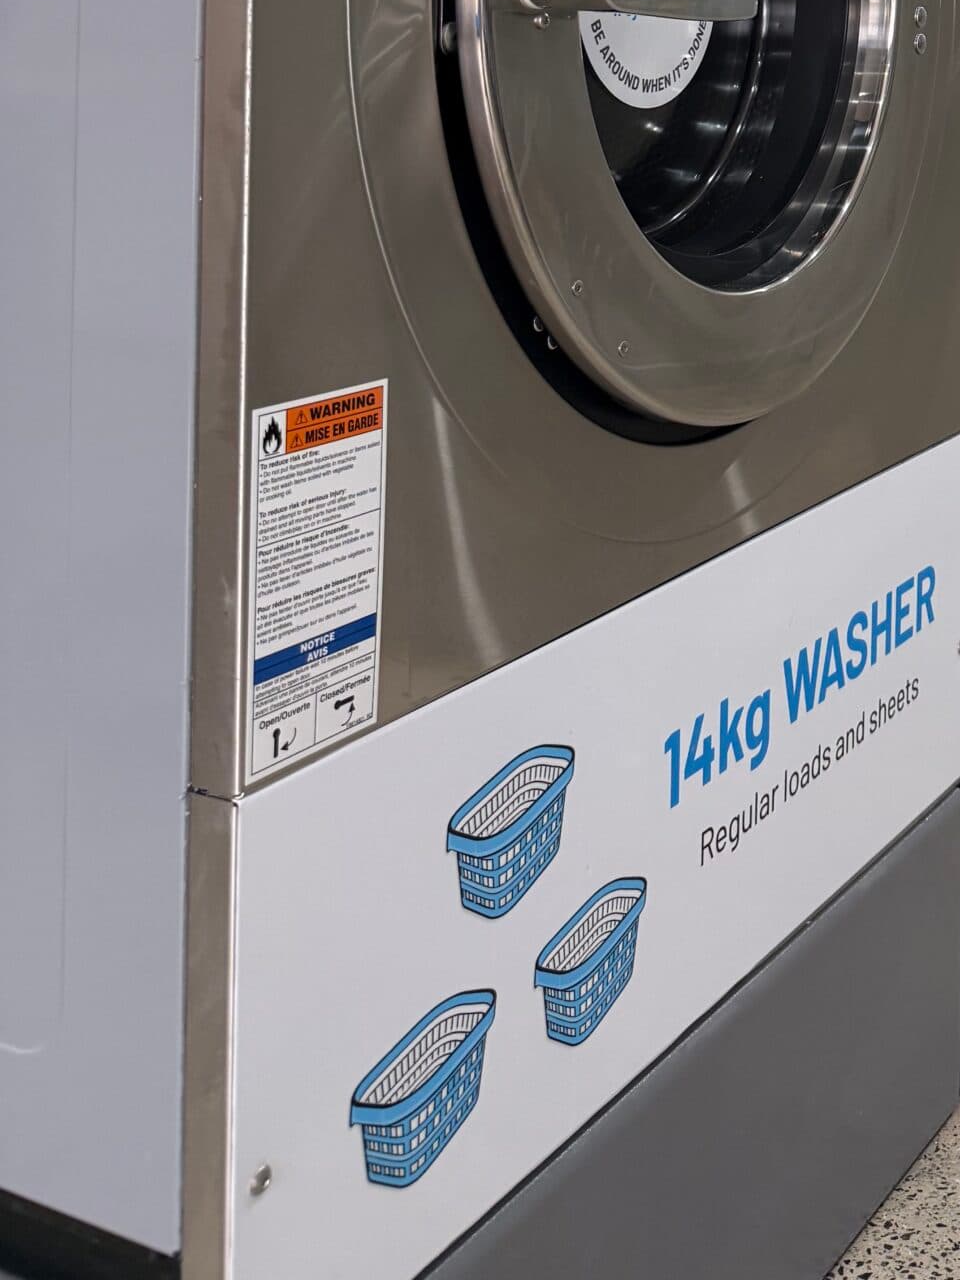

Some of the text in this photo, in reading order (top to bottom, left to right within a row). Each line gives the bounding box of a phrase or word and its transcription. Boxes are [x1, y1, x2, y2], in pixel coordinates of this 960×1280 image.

[591, 19, 706, 93] BE AROUND WHEN IT'S DONE
[310, 392, 374, 420] WARNING
[305, 413, 378, 443] MISE EN GARDE
[268, 457, 288, 468] reduce
[289, 453, 300, 462] risk
[302, 451, 307, 459] of
[309, 448, 320, 457] fire:
[259, 511, 266, 520] To
[267, 504, 288, 518] reduce
[288, 501, 299, 511] risk
[301, 498, 307, 507] of
[308, 492, 328, 505] serious
[258, 547, 272, 559] Pour
[295, 538, 300, 546] le
[301, 532, 319, 544] risque
[257, 603, 270, 615] Pour
[293, 592, 301, 602] les
[302, 584, 322, 598] risques
[323, 581, 330, 590] de
[300, 630, 335, 653] NOTICE
[307, 645, 328, 662] AVIS
[320, 672, 370, 703] Closed/Fermée
[664, 565, 936, 809] 14kg WASHER
[259, 699, 310, 731] Open/Ouverte
[700, 677, 919, 867] Regular loads and sheets
